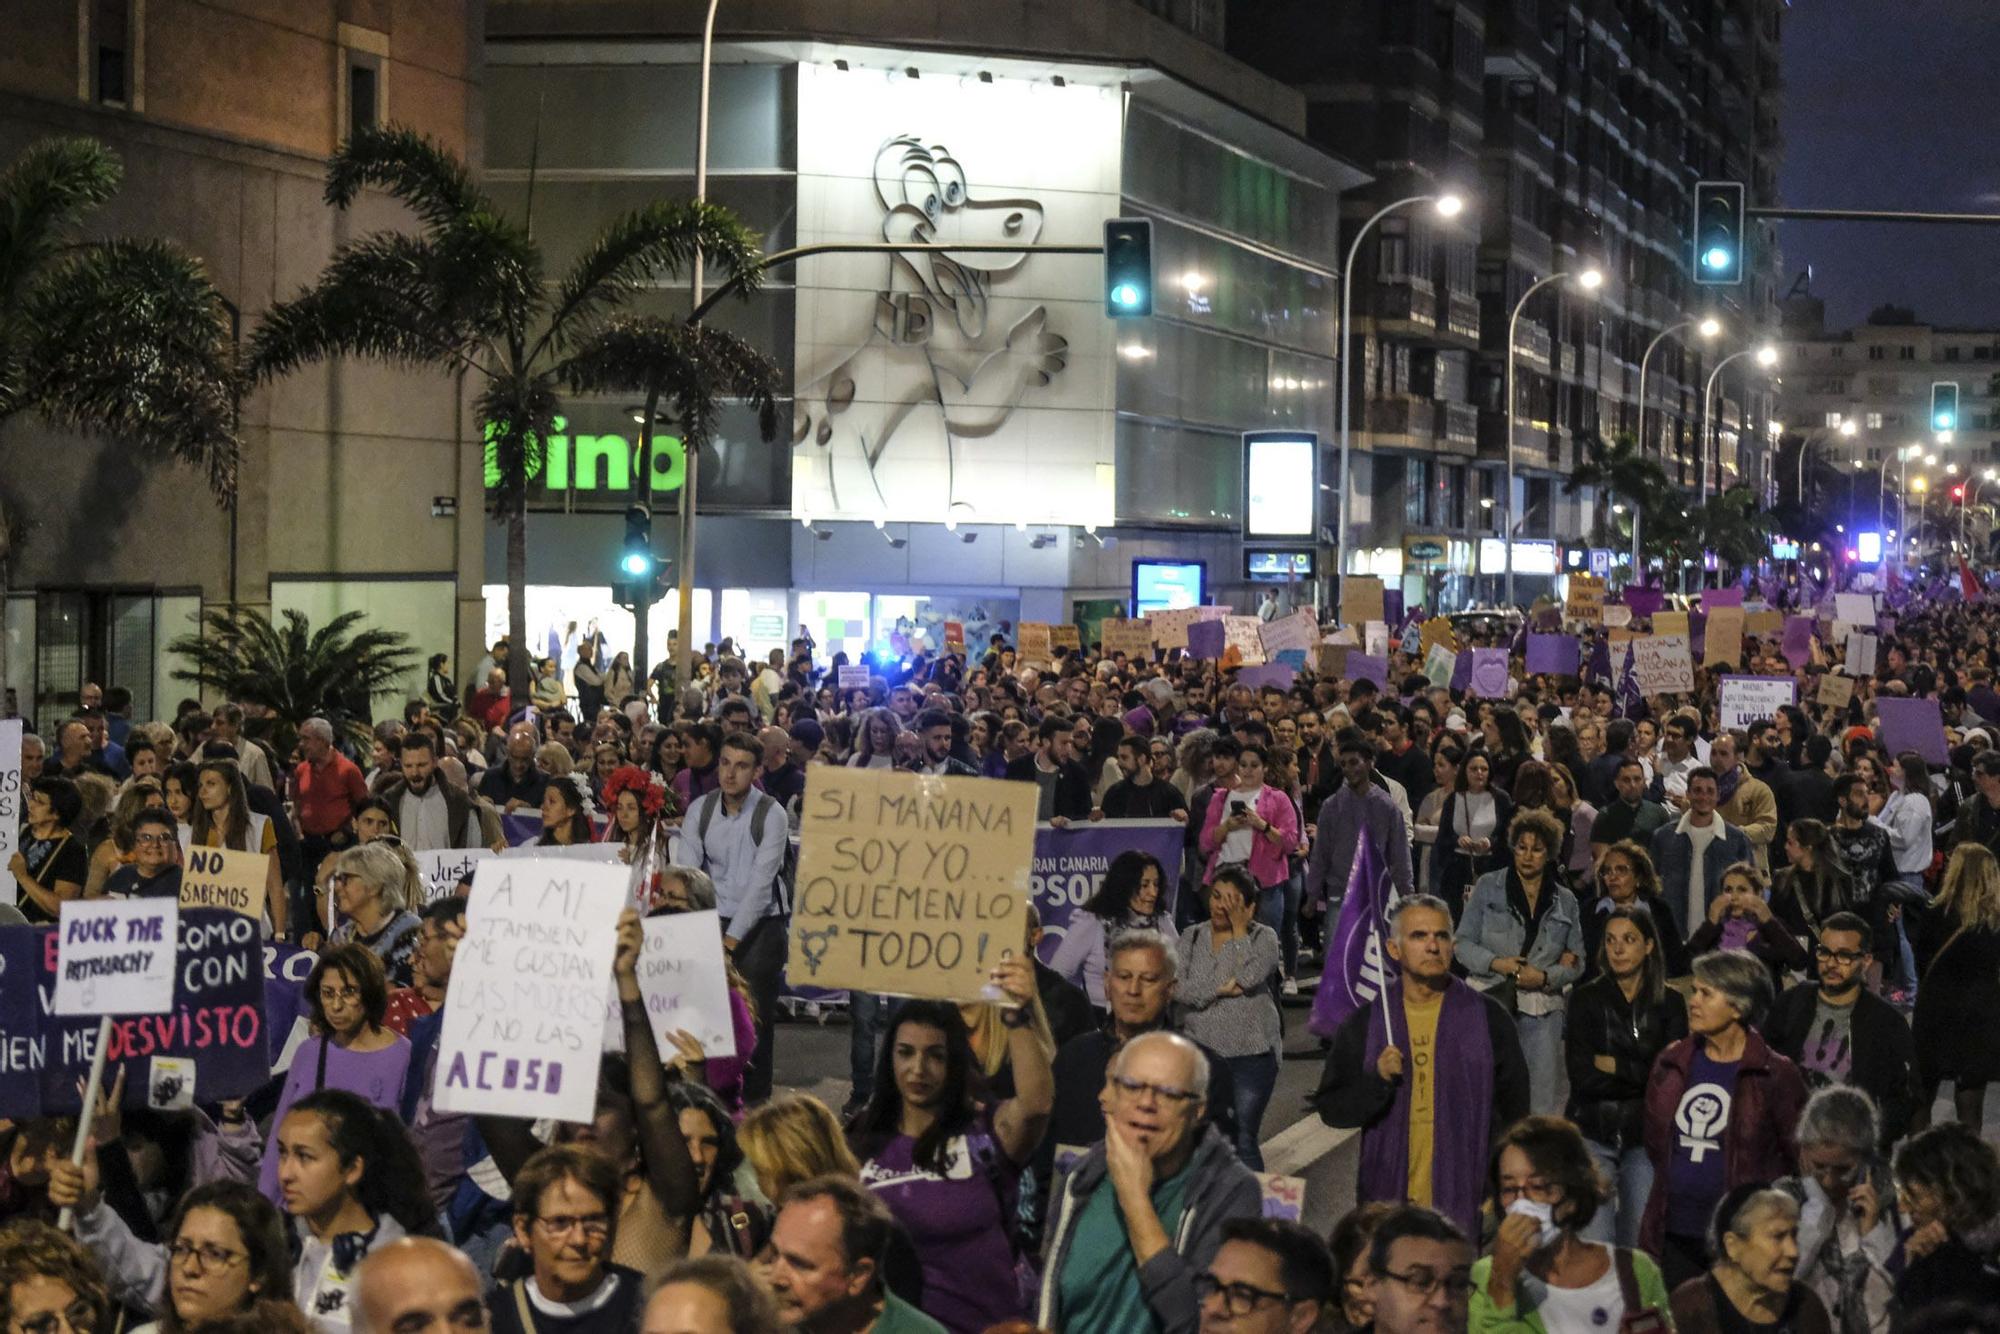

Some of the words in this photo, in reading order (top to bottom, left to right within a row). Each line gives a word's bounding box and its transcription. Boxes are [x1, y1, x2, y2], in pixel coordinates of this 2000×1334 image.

[811, 789, 855, 821] SI
[189, 850, 224, 875] NO
[831, 837, 910, 877] SOY
[1059, 856, 1110, 872] CANARIA
[181, 882, 249, 908] SABEMOS
[487, 873, 513, 907] A
[537, 878, 586, 921] MI
[67, 915, 118, 945] FUCK
[127, 915, 163, 943] THE
[184, 952, 248, 993] CON
[461, 938, 496, 966] ME
[514, 946, 594, 980] GUSTAN
[63, 1027, 98, 1066] ME
[492, 1018, 522, 1043] NO
[535, 1021, 583, 1052] LAS
[445, 1050, 563, 1095] ACOSO
